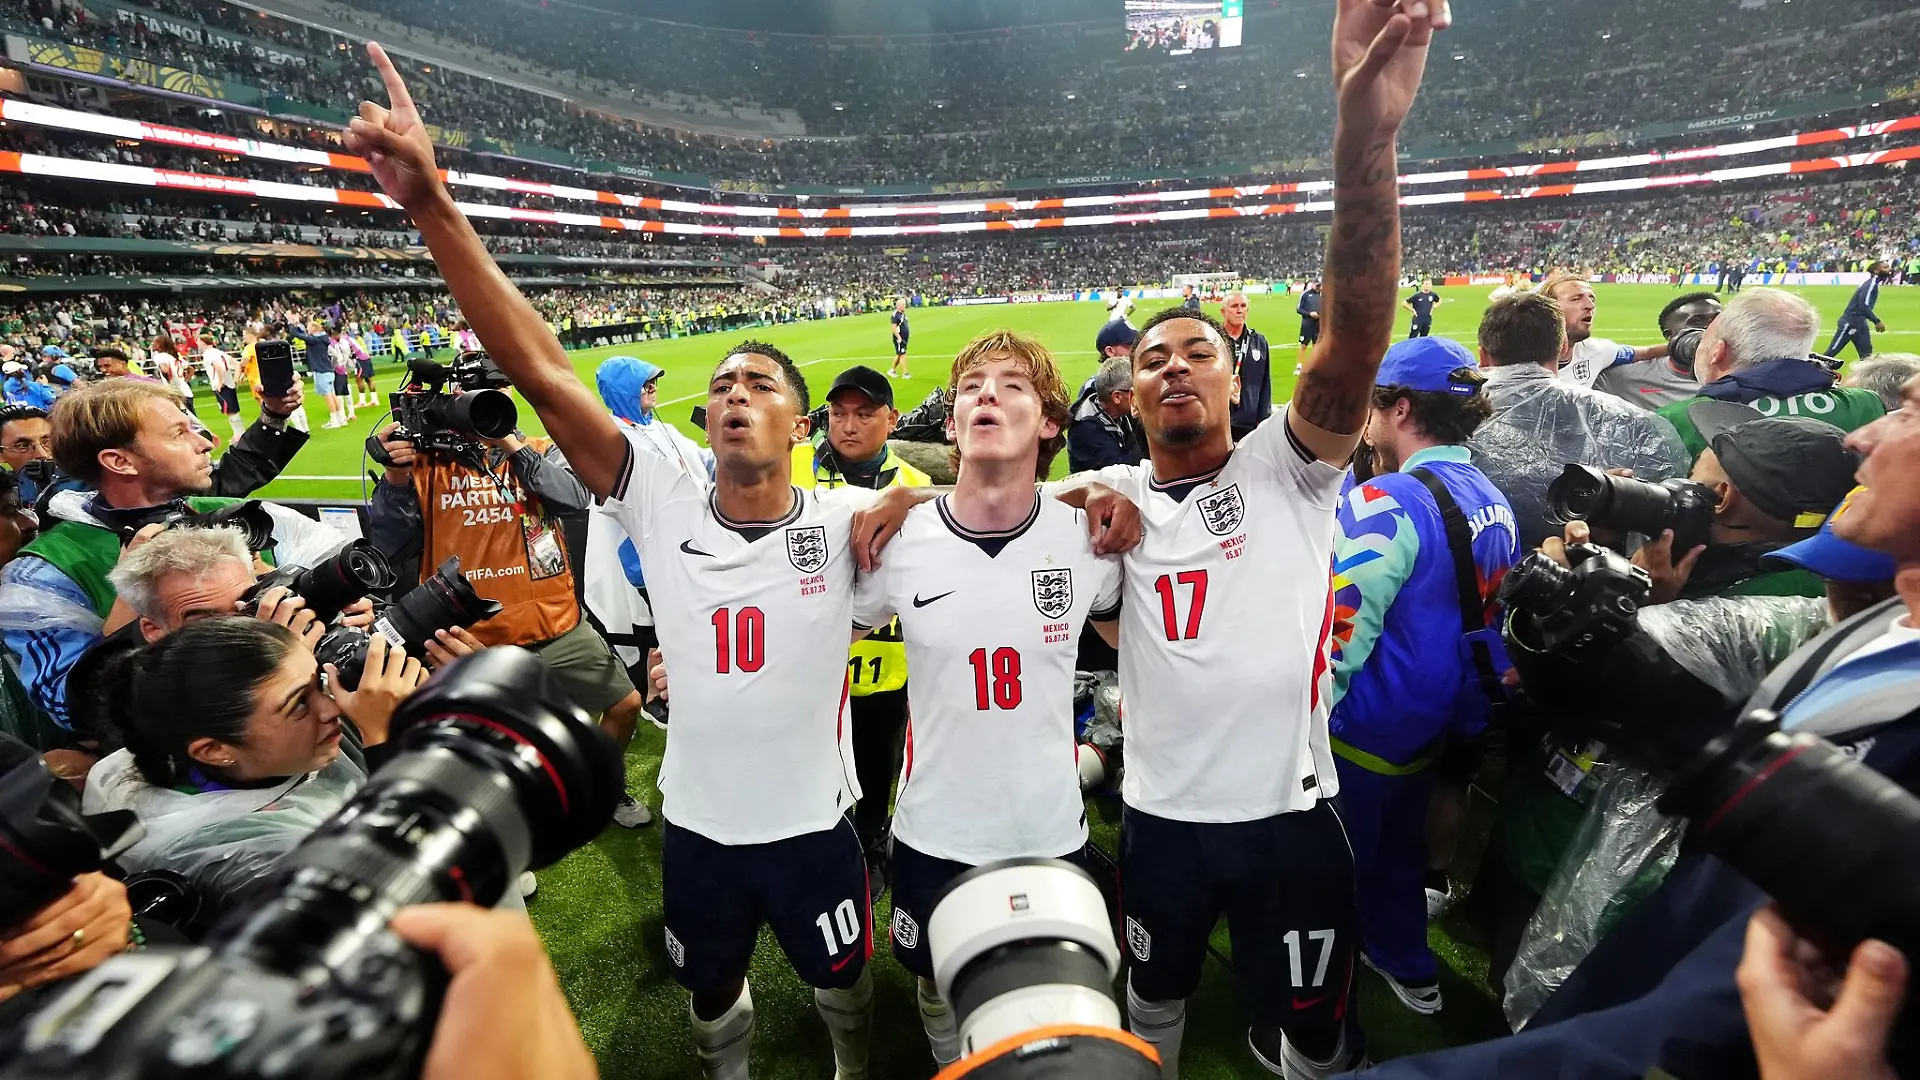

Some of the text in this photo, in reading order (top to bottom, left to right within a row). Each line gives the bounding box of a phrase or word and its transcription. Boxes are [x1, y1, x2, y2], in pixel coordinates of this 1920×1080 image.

[1687, 109, 1777, 129] MEXICO CITY
[1615, 273, 1638, 284] QATAR
[1012, 294, 1038, 304] QATAR
[441, 487, 527, 510] PARTNR
[463, 507, 514, 527] 2454
[1220, 533, 1247, 549] MEXICO
[465, 565, 525, 581] FIFA.com
[800, 575, 825, 586] MEXICO
[1154, 568, 1209, 642] 17
[1043, 622, 1069, 633] MEXICO
[711, 606, 765, 674] 10
[1045, 633, 1069, 644] 05.07.26
[968, 646, 1023, 711] 18
[816, 898, 861, 956] 10
[1283, 928, 1336, 987] 17
